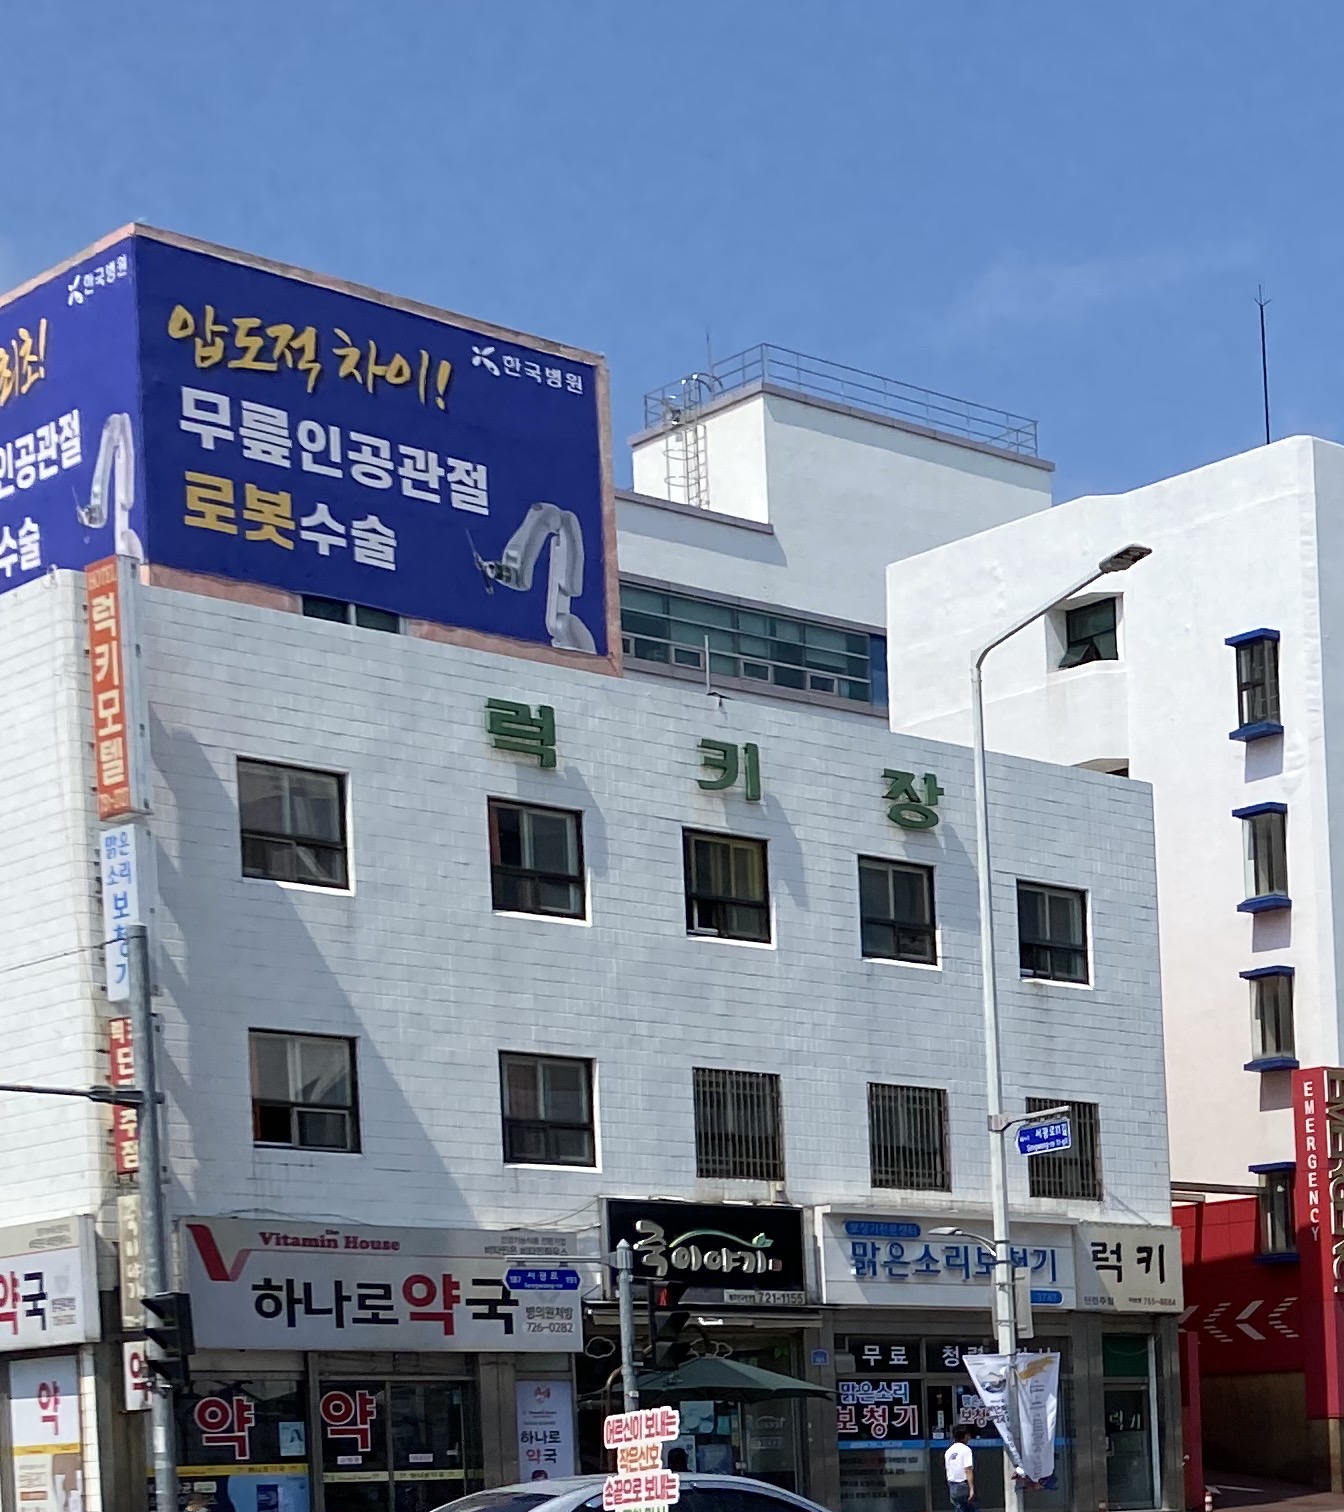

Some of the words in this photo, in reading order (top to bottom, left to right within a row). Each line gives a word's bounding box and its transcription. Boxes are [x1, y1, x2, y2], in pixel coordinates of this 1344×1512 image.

[167, 304, 319, 393] 압도적
[334, 328, 453, 411] 차이!
[502, 354, 584, 395] 한국병원
[179, 386, 490, 517] 무릎인공관절
[183, 472, 397, 571] 로봇수술
[91, 592, 125, 788] 럭키모텔
[1303, 1080, 1320, 1242] EMERGENCY
[259, 1231, 339, 1250] Vitamin
[343, 1236, 400, 1252] House
[1091, 1241, 1166, 1284] 럭키
[251, 1273, 519, 1335] 하나로약국
[526, 1322, 573, 1333] 726-0282
[862, 1345, 909, 1366] 무료
[36, 1381, 61, 1436] 약
[839, 1382, 910, 1404] 맑은소리
[194, 1396, 255, 1460] 약
[320, 1390, 377, 1452] 약
[520, 1430, 561, 1445] 하나로
[606, 1414, 643, 1444] 어르신이
[645, 1410, 677, 1439] 보내는
[836, 1406, 919, 1438] 보청기
[525, 1447, 557, 1464] 약국
[645, 1474, 677, 1501] 보내는
